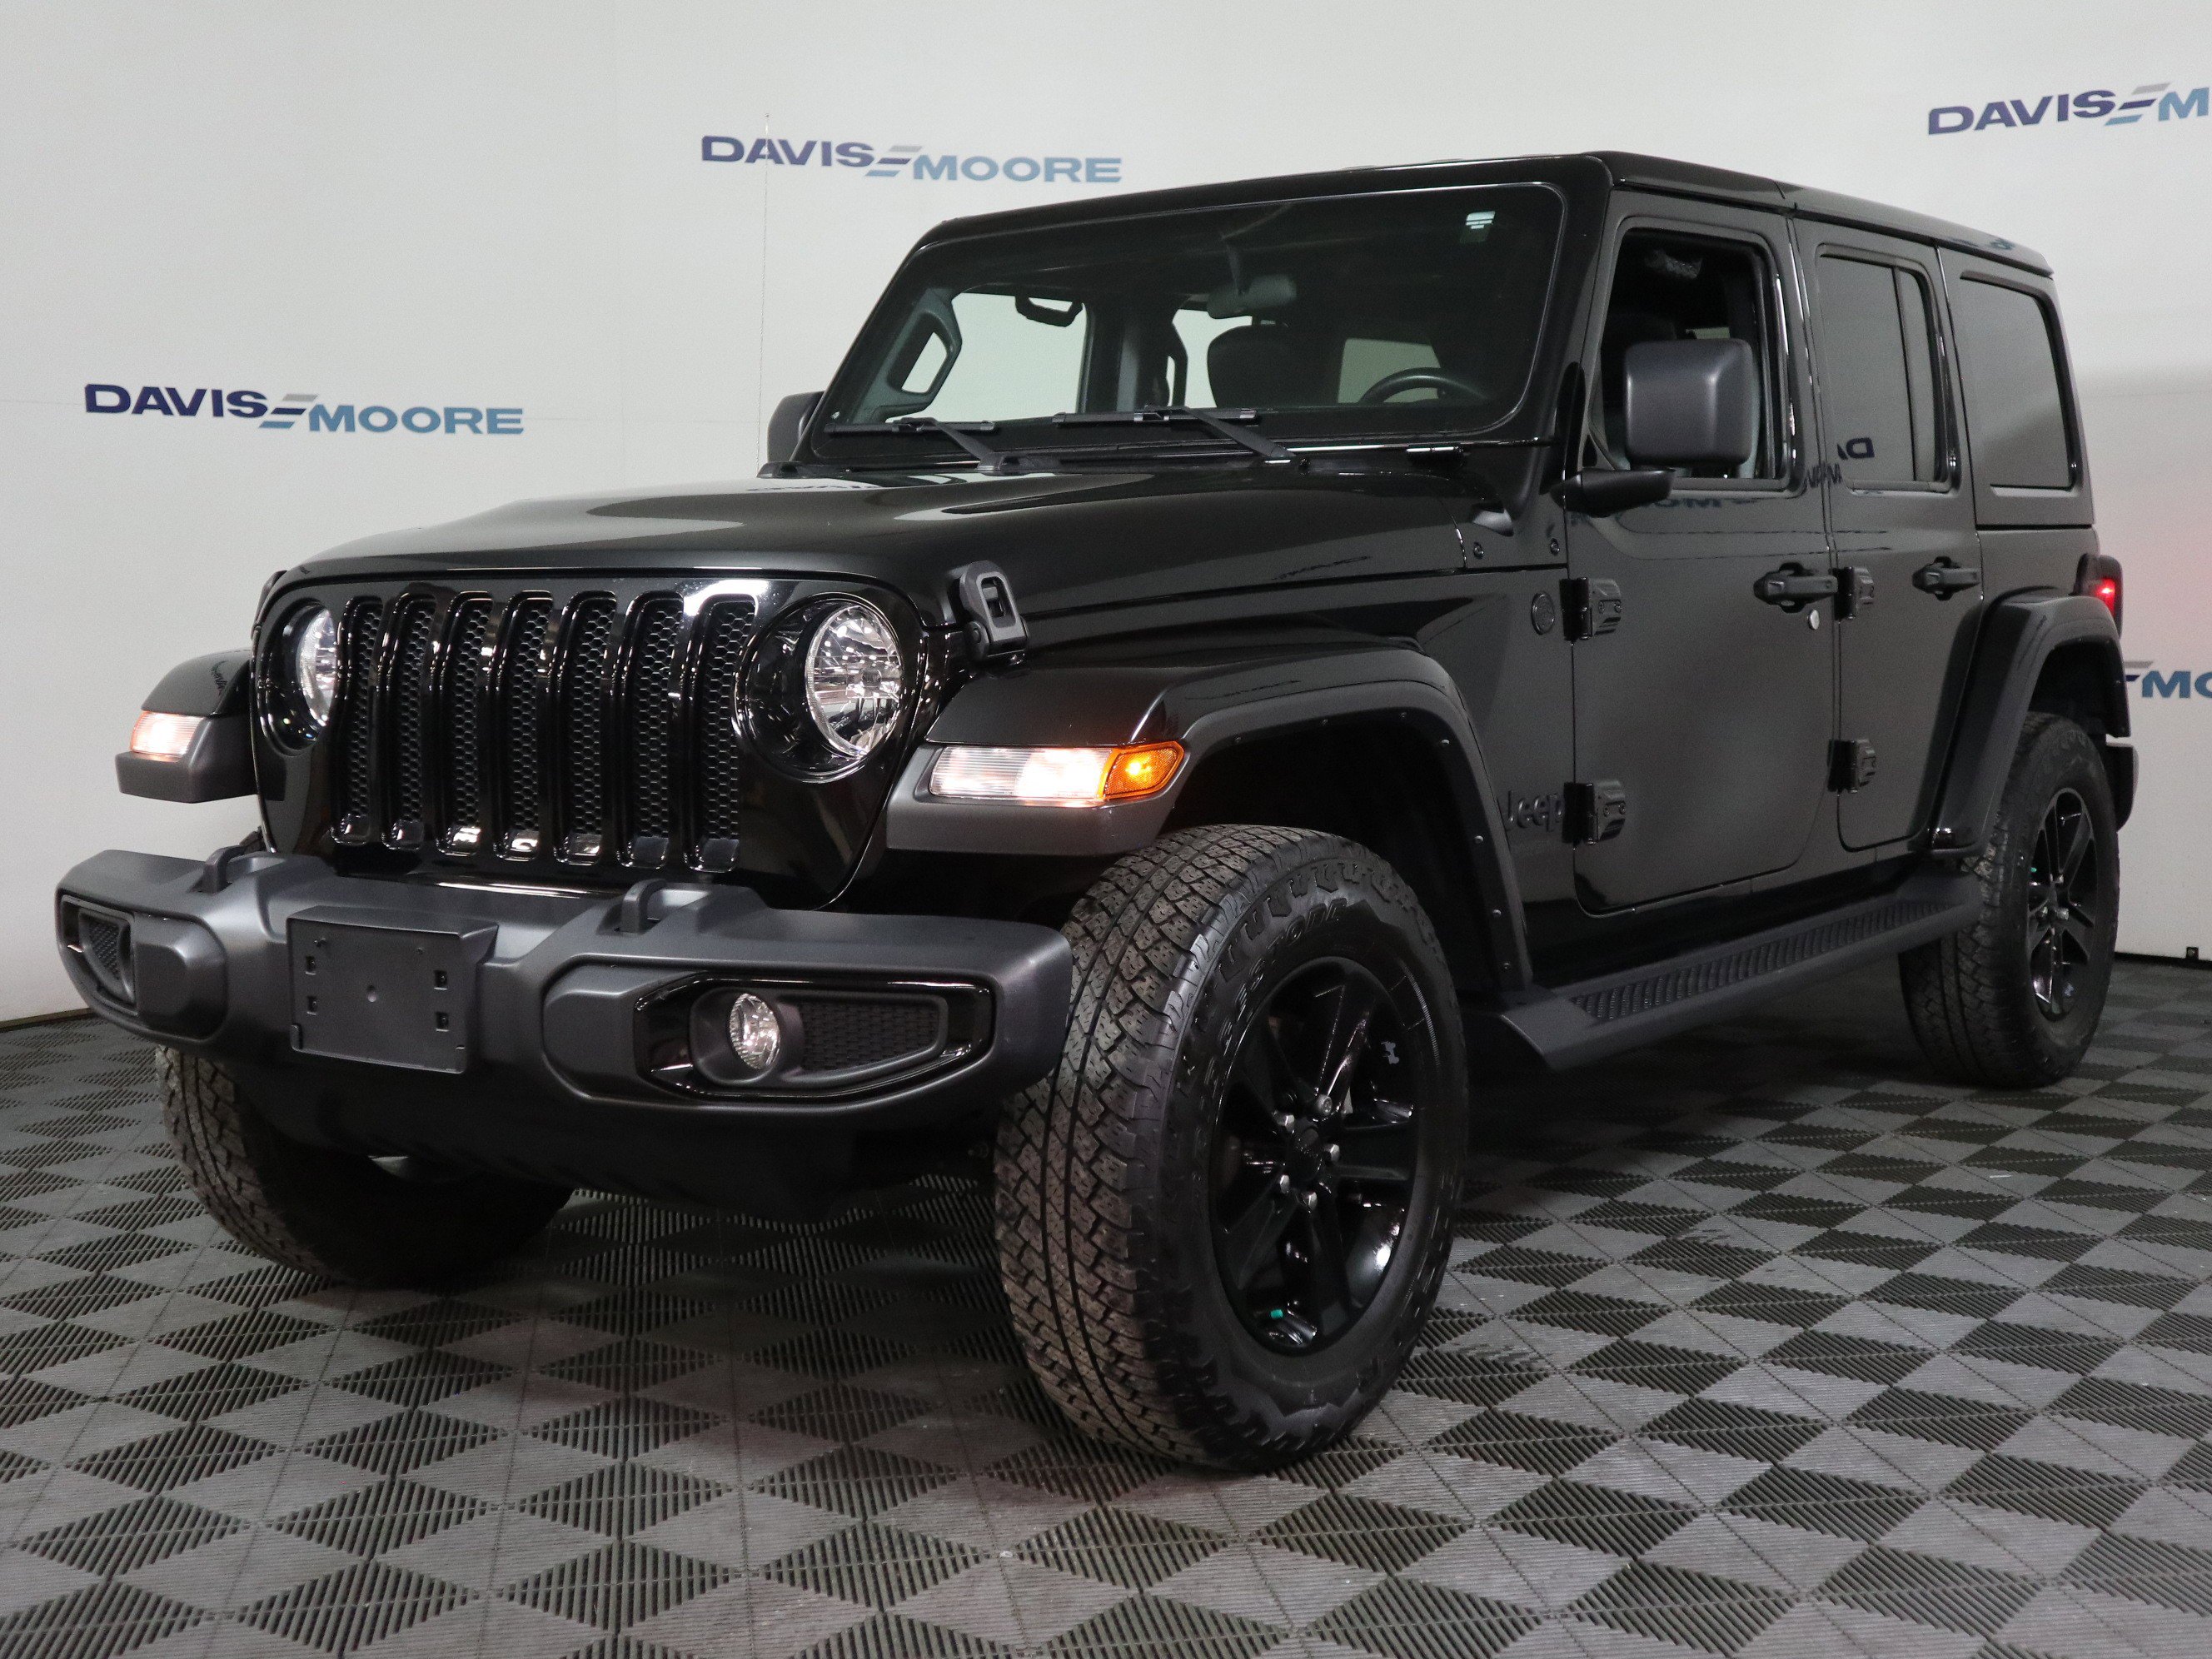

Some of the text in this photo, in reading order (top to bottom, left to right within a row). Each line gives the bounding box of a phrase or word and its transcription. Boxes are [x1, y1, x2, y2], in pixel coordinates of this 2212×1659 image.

[1927, 89, 2117, 137] DAVIS
[701, 136, 1123, 184] DAVIS MOORE
[84, 384, 526, 436] DAVIS MOORE
